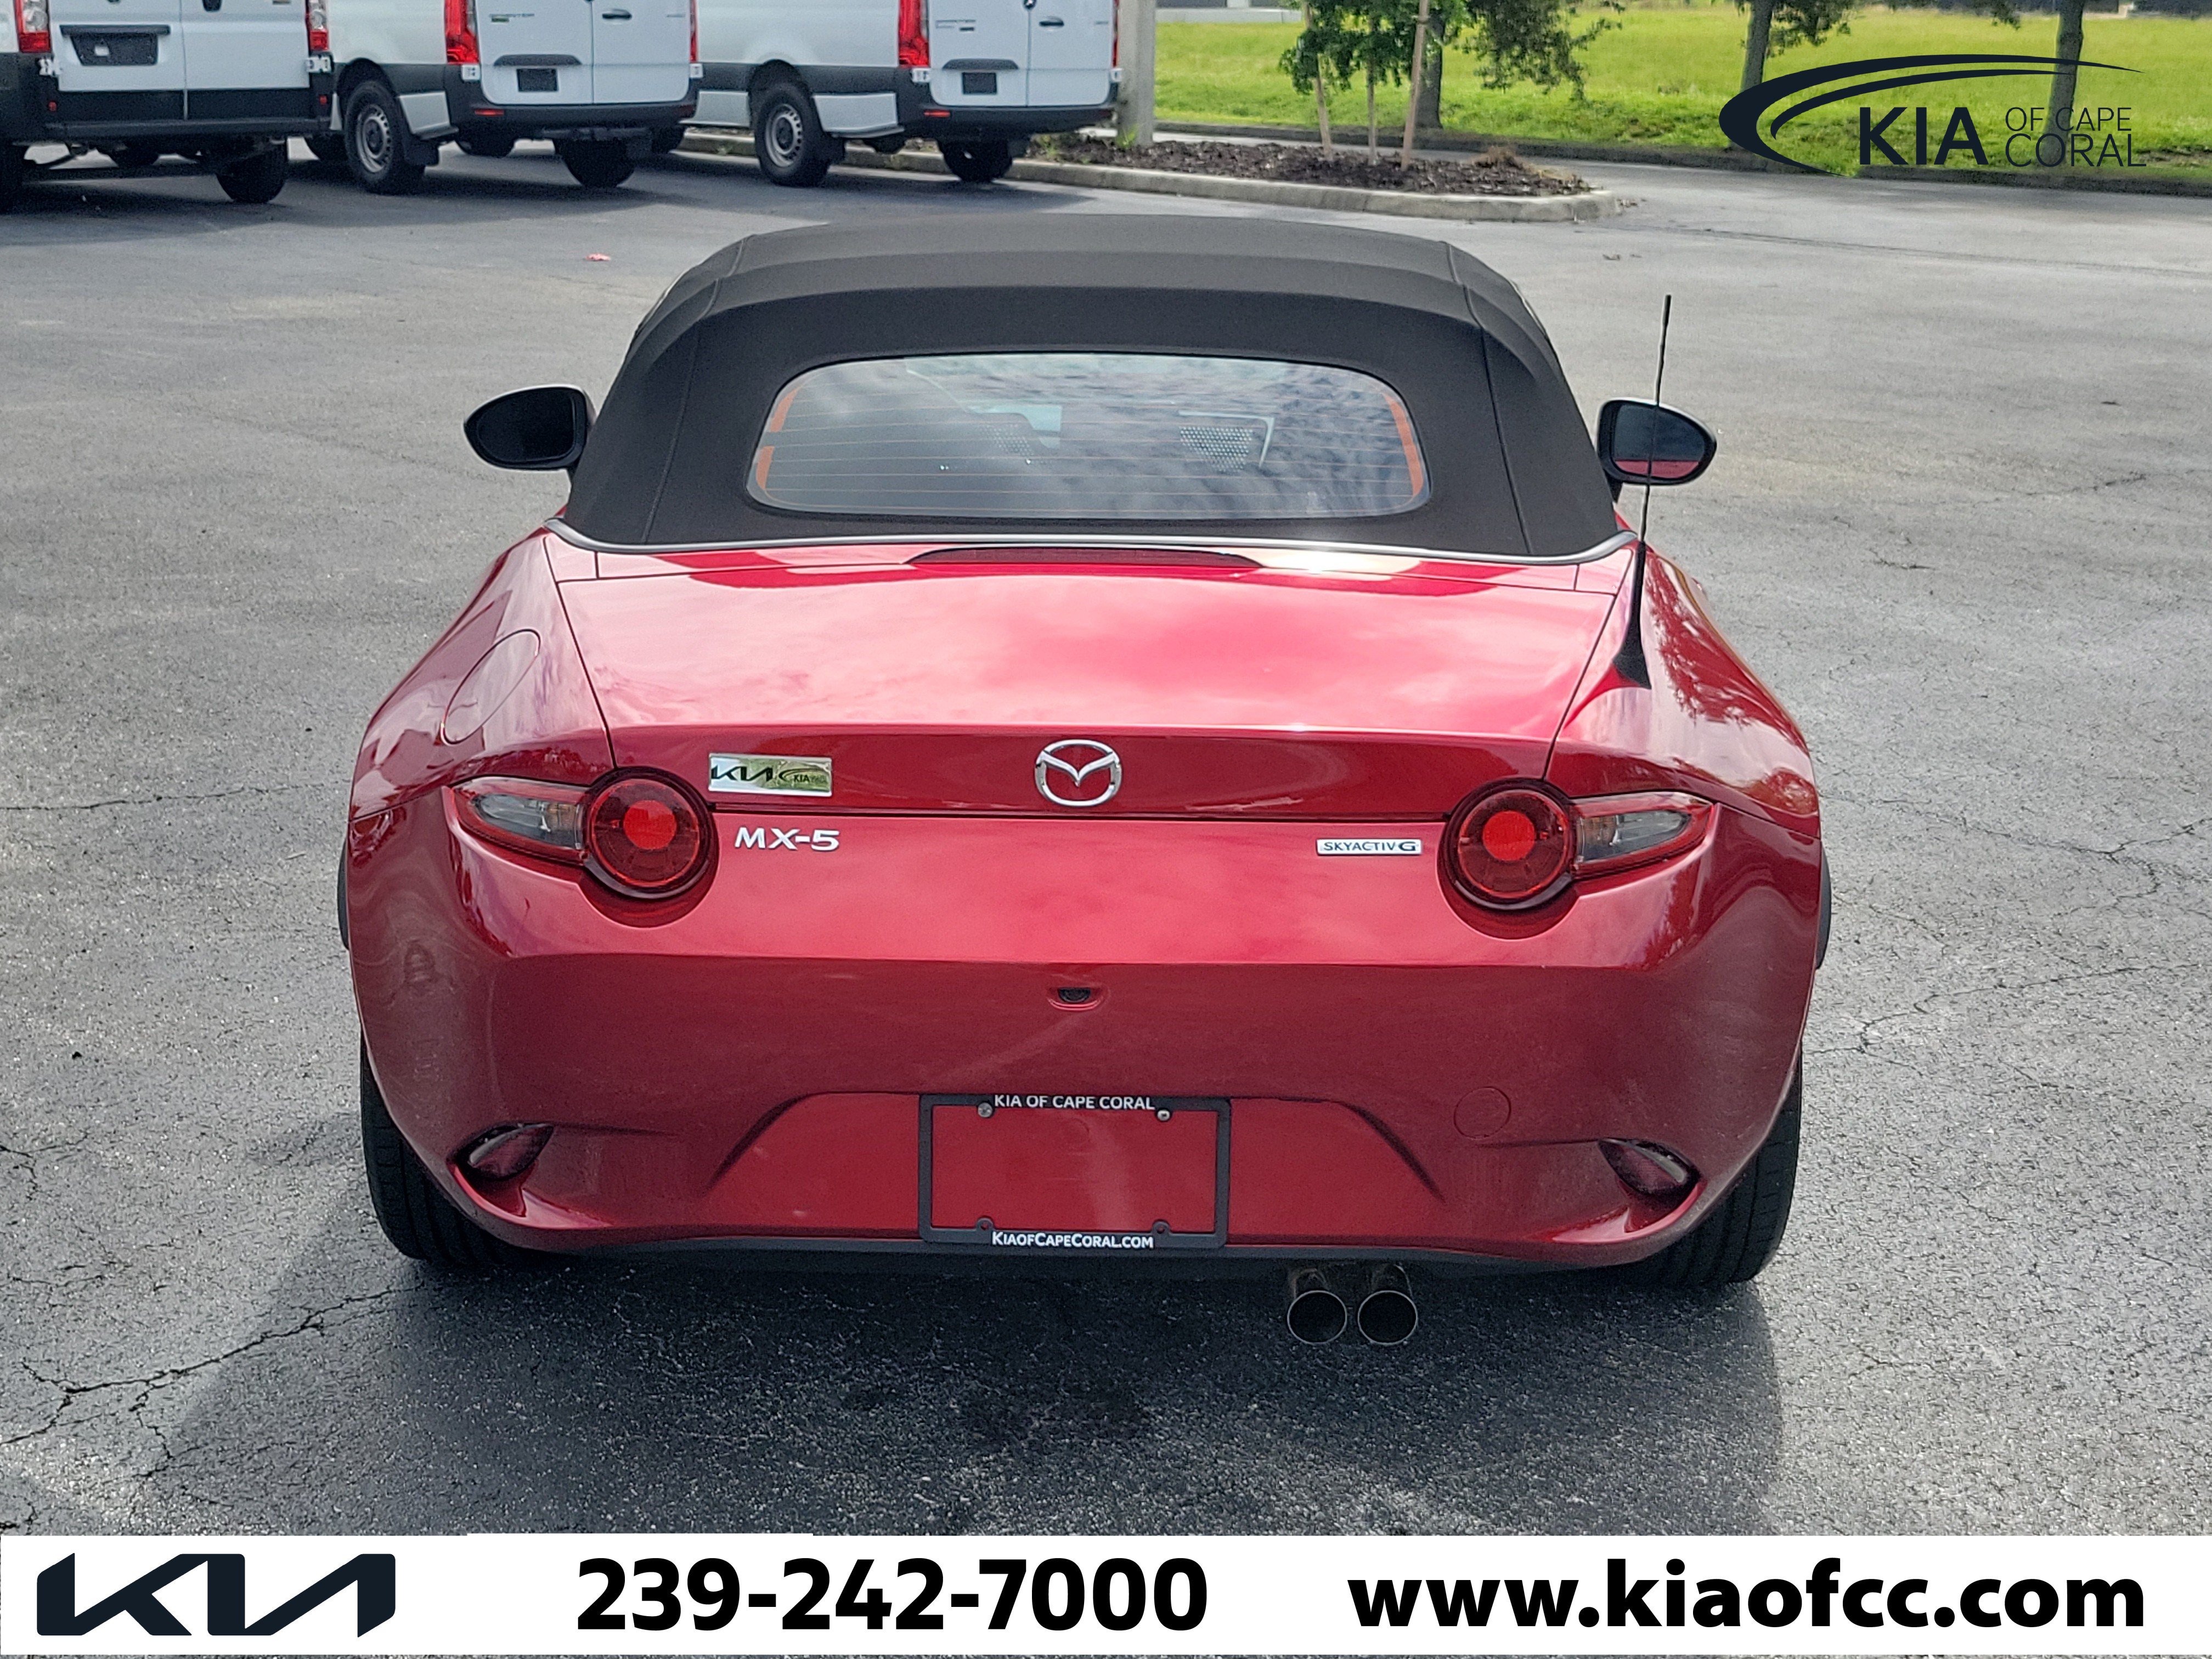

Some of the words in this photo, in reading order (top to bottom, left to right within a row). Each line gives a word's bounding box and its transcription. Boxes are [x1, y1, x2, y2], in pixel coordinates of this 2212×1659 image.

[793, 774, 810, 783] KIA
[734, 827, 840, 851] MX-5
[995, 1094, 1022, 1108] KIA
[1026, 1095, 1048, 1108] OF
[1052, 1096, 1096, 1109] CAPE
[1099, 1096, 1155, 1110] CORAL
